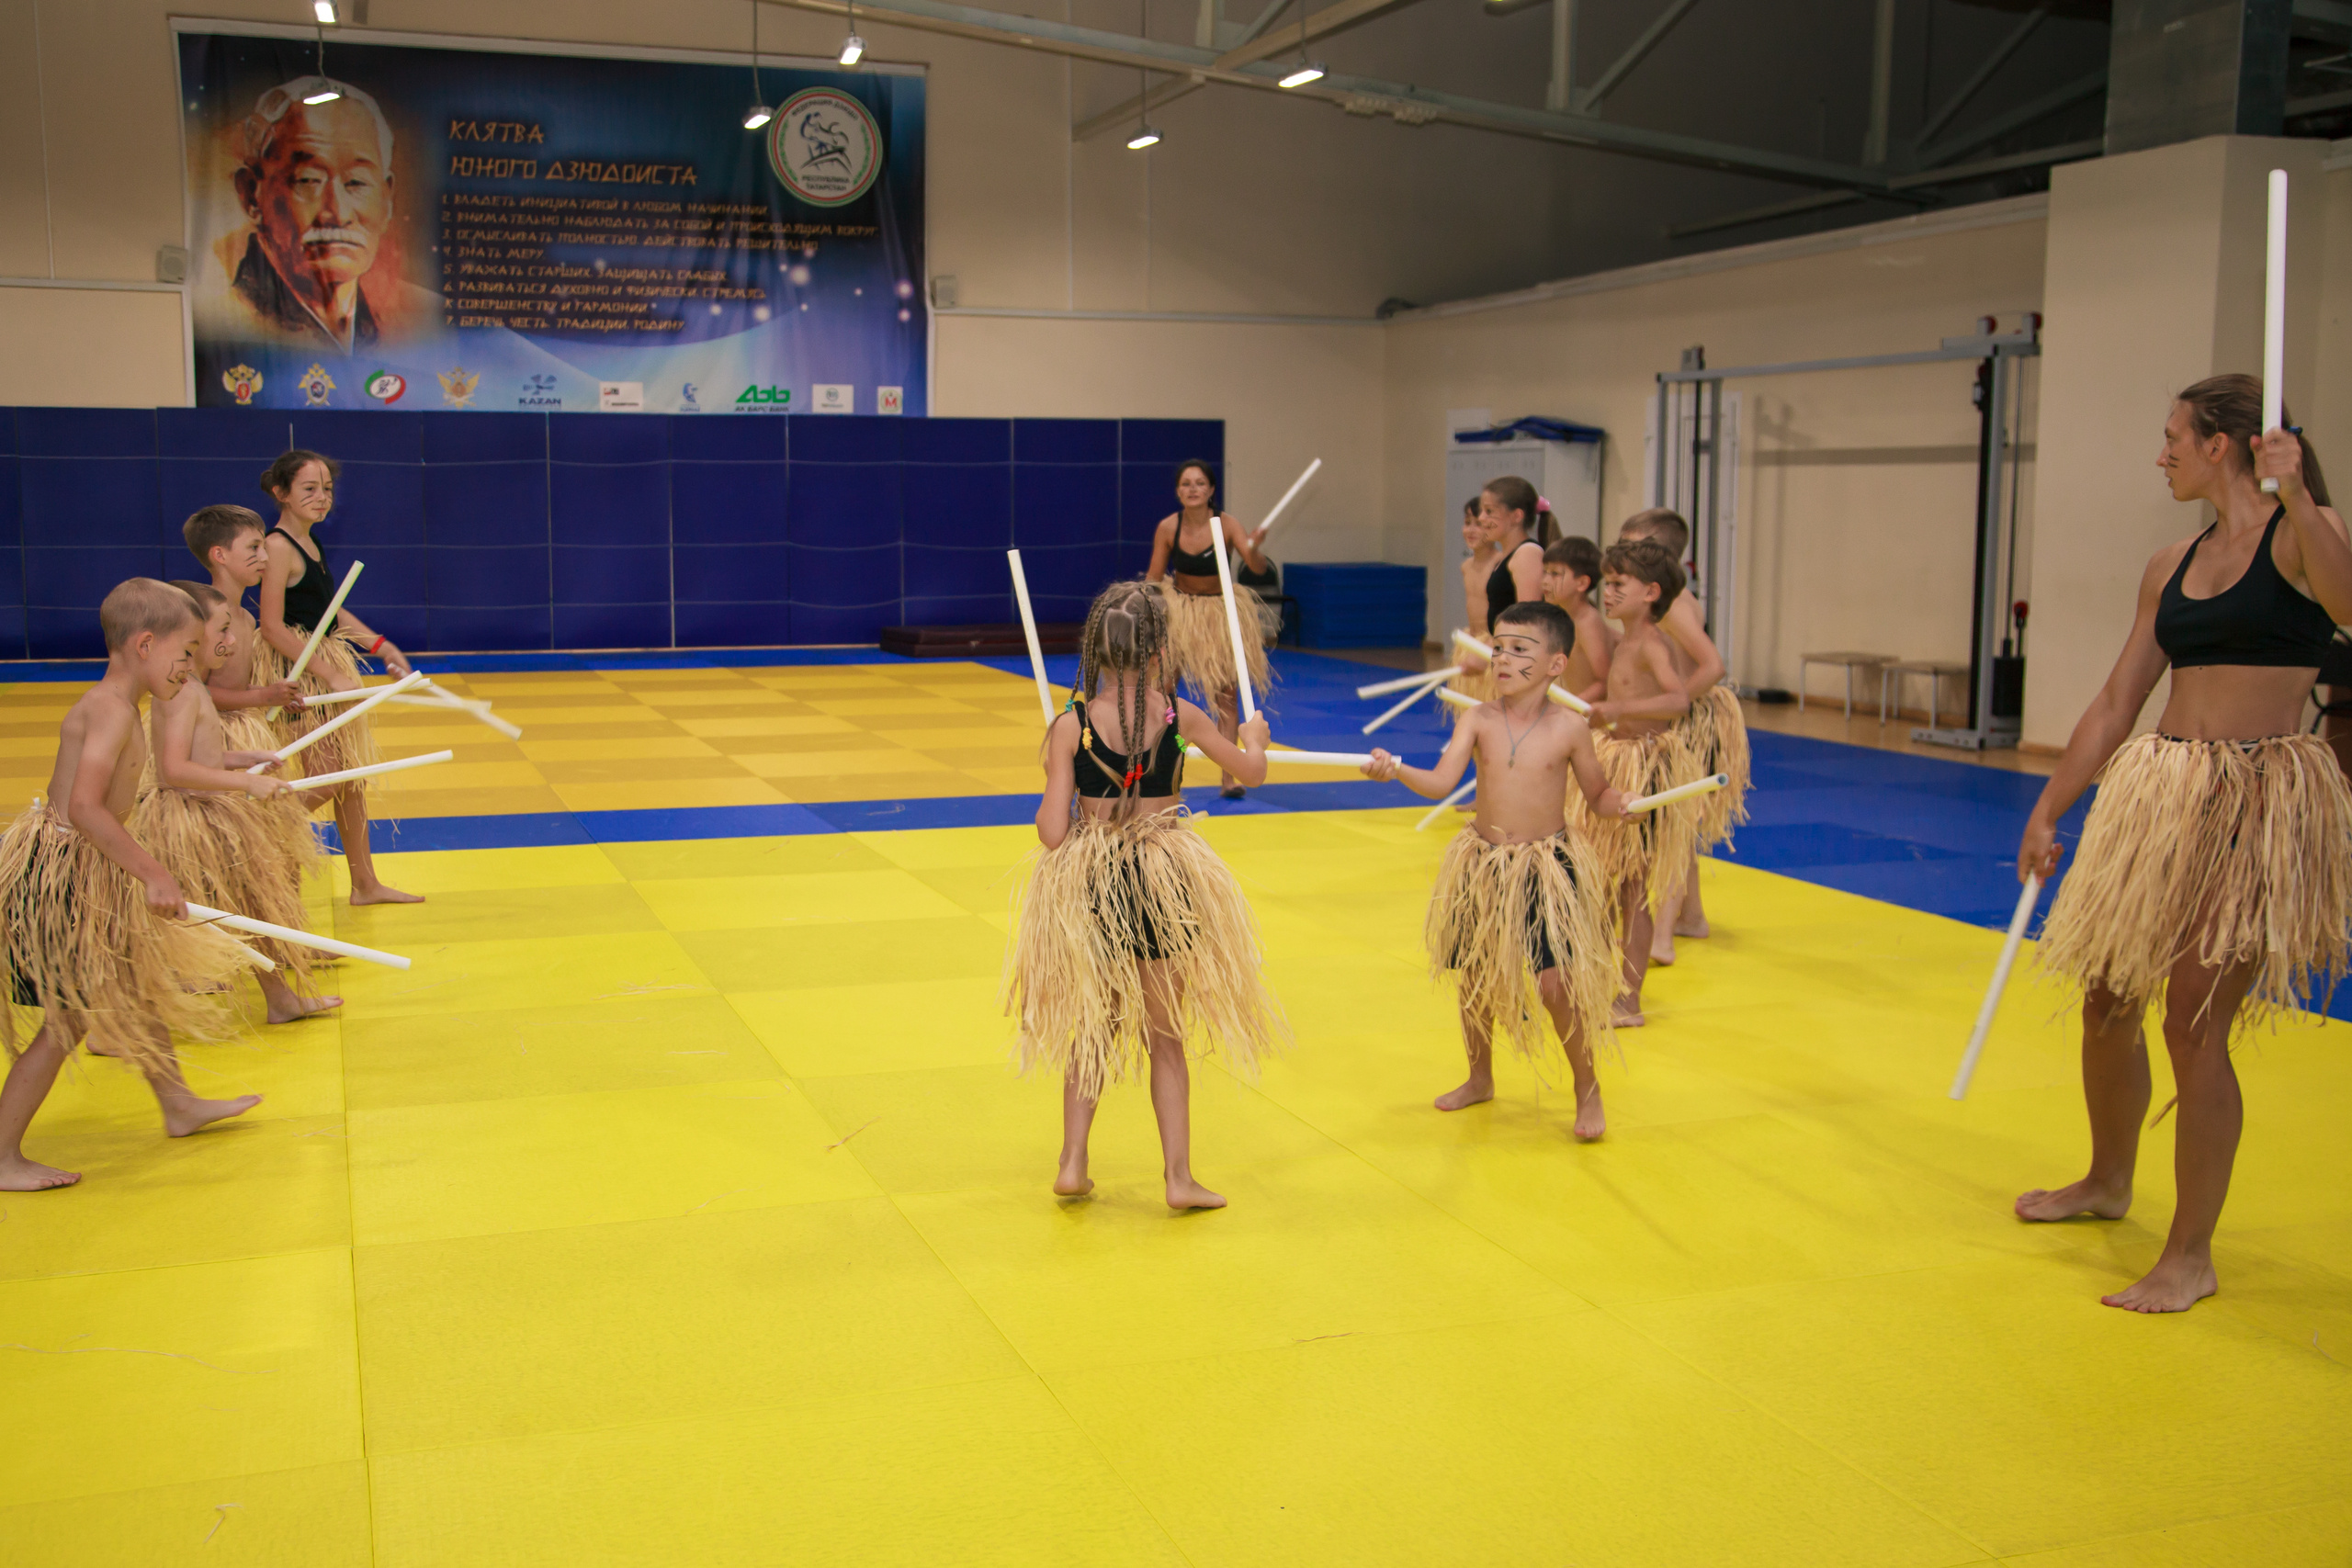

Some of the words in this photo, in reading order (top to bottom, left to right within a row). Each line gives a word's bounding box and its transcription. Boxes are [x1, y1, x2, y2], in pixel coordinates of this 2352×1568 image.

[449, 119, 544, 144] КЛЯТВА
[450, 156, 537, 180] ЮНОГО
[545, 160, 697, 186] ДЗЮДОИСТА
[801, 175, 850, 183] РЕСПУБЛИКА
[806, 183, 847, 191] ТАТАРСТАН
[454, 194, 516, 207] ВЛАДЕТЬ
[520, 197, 618, 212] ИНИЦИАТИВОЙ
[633, 201, 682, 213] ЛЮБОМ
[458, 211, 560, 226] ВНИМАТЕЛЬНО
[564, 215, 649, 229] НАБЛЮДАТЬ
[653, 219, 670, 230] ЗА
[673, 218, 713, 231] СОБОЙ
[456, 229, 553, 243] ОСМЫСЛИВАТЬ
[458, 245, 503, 258] ЗНАТЬ
[460, 264, 524, 276] УВАЖАТЬ
[596, 266, 674, 283] ЗАЩИЩАТЬ
[459, 280, 548, 294] РАЗВИВАТЬСЯ
[549, 283, 609, 296] ДУХОВНО
[612, 286, 623, 296] И
[560, 301, 571, 311] И
[459, 315, 505, 328] БЕРЕЧЬ
